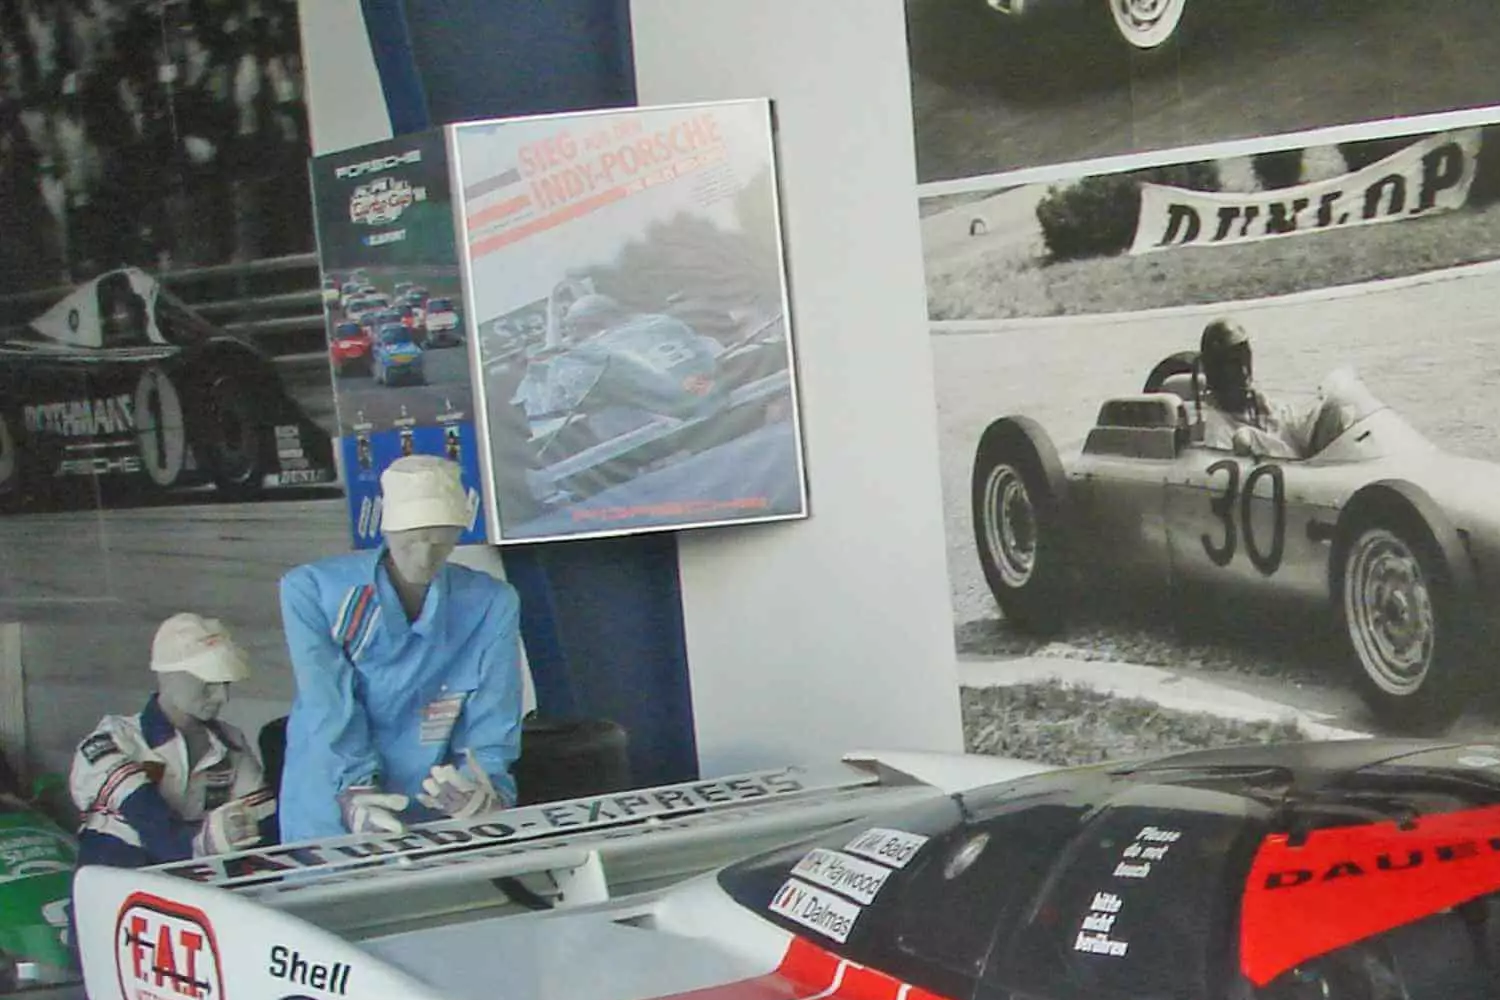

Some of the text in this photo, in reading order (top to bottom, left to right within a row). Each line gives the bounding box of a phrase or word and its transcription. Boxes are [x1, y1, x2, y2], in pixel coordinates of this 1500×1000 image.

[518, 132, 578, 178] SIEG
[529, 112, 723, 210] INDY-PORSCHE
[1201, 459, 1286, 577] 30
[1123, 842, 1169, 860] do not
[1135, 826, 1182, 842] Please
[822, 857, 884, 896] Haywood
[790, 889, 852, 936] Y. Dalmas
[269, 945, 352, 996] Shell
